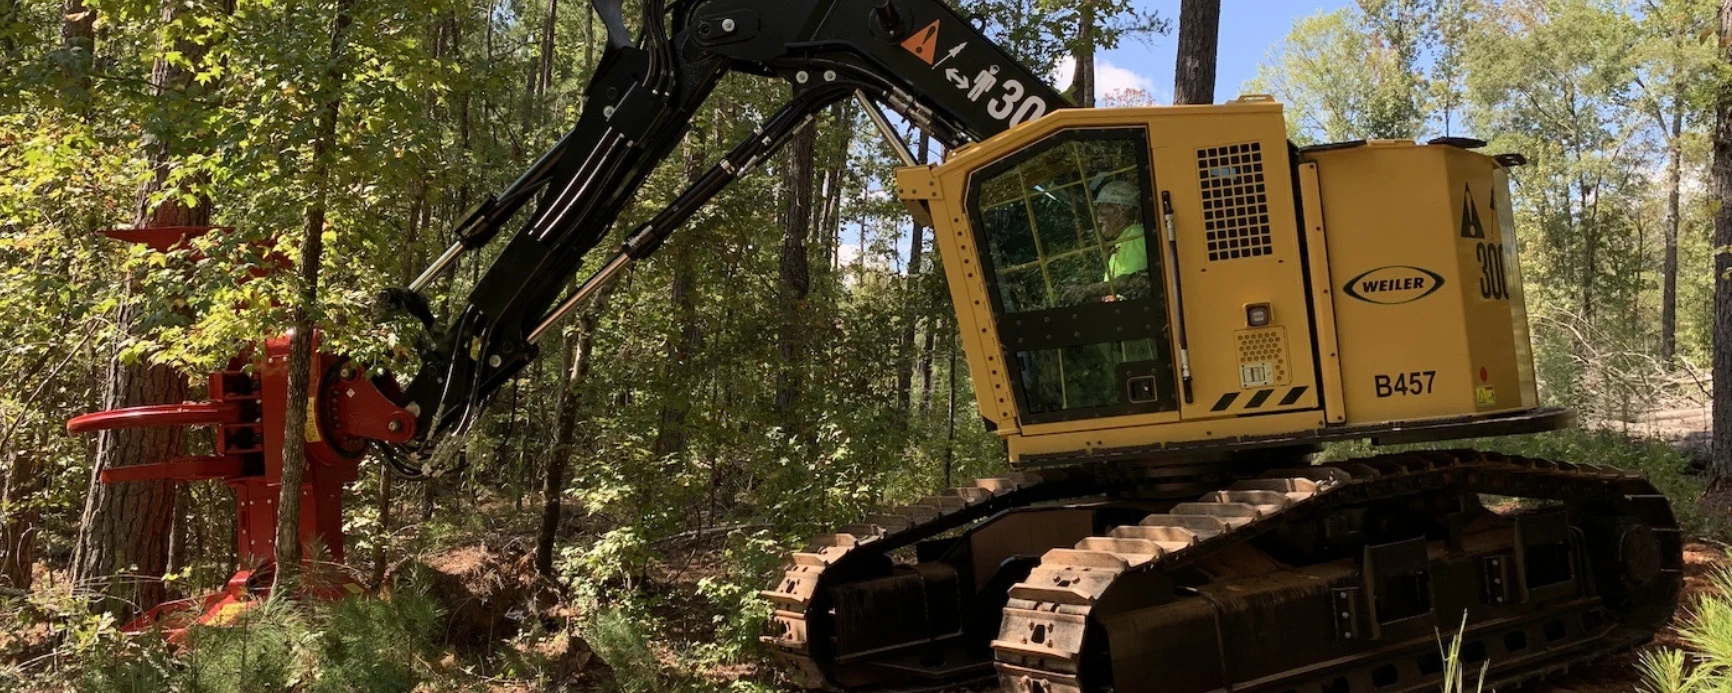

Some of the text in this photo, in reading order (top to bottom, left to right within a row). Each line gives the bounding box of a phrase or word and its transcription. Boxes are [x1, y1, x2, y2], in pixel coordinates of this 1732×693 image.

[987, 79, 1046, 129] 30
[1362, 277, 1425, 293] WEILER
[1374, 370, 1436, 398] B457
